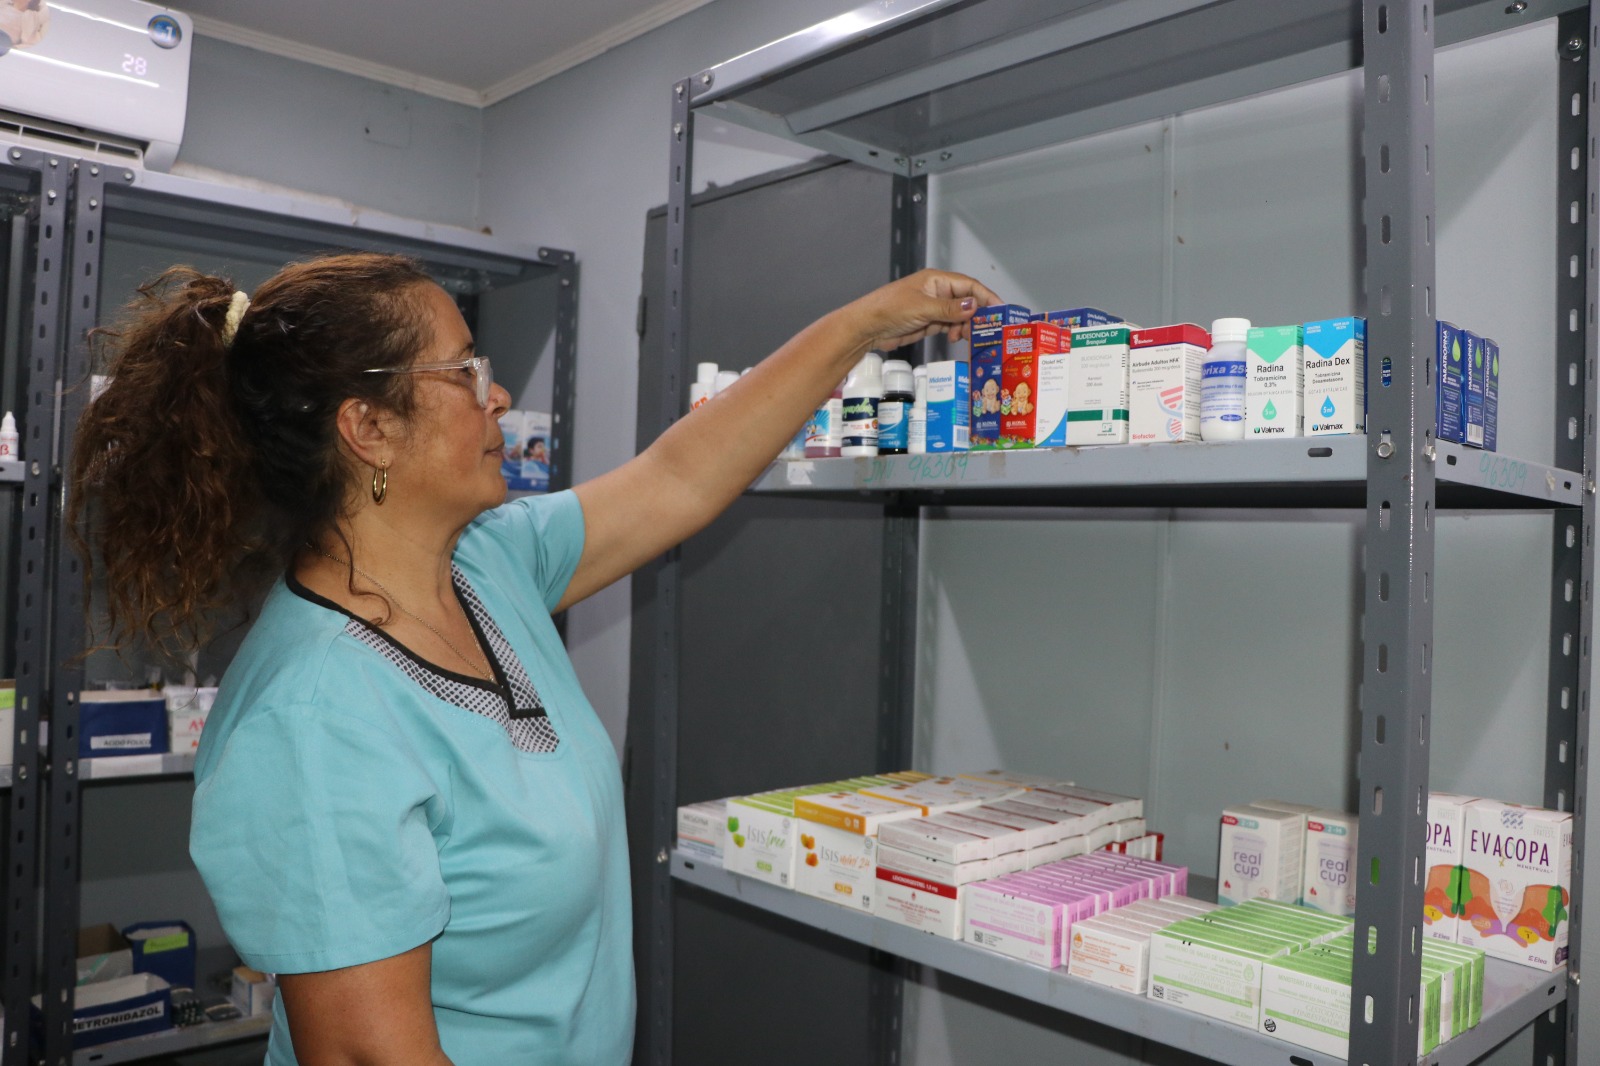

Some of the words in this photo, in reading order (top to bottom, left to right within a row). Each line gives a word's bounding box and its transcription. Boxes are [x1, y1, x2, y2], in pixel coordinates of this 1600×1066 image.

[122, 53, 147, 76] 28
[1076, 332, 1109, 340] BUDESONIDA
[1230, 364, 1247, 374] 25
[1256, 364, 1284, 373] Radina
[1305, 360, 1333, 369] Radina
[1335, 357, 1350, 365] Dex
[1319, 423, 1343, 431] Valmax
[908, 453, 968, 481] 96309
[1479, 452, 1528, 491] 96309
[747, 824, 766, 843] ISIS
[765, 829, 786, 849] free
[821, 845, 839, 864] ISIS
[1470, 829, 1550, 867] EVACOPA
[1233, 851, 1262, 865] real
[1319, 857, 1350, 873] real
[1234, 863, 1260, 878] cup
[1516, 863, 1550, 874] MENSTRUAL
[1320, 870, 1347, 885] cup
[1534, 956, 1548, 965] Elea
[1305, 981, 1312, 989] DE
[1314, 983, 1330, 994] SALUD
